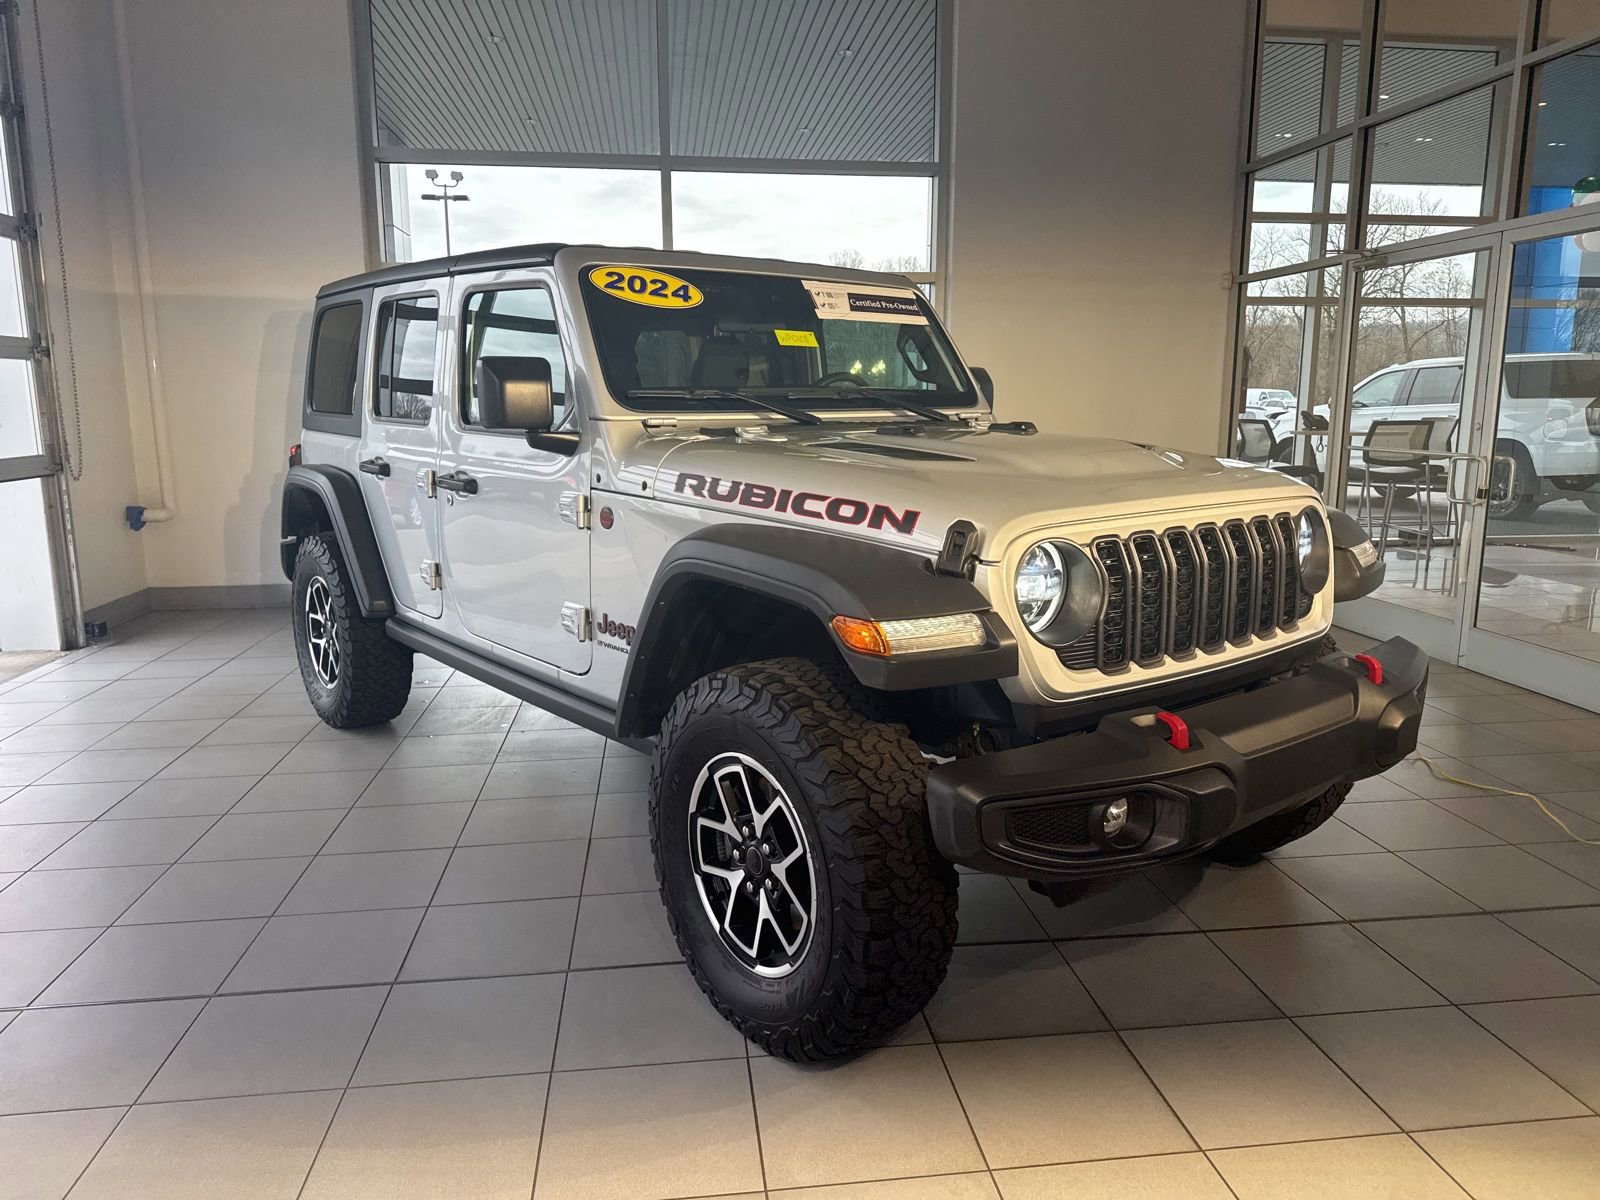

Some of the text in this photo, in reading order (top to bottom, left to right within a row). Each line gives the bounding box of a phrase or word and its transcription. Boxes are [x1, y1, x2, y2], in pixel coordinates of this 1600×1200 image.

[603, 271, 692, 304] 2024
[850, 299, 881, 308] Certified
[882, 302, 918, 311] Pre-Owned
[674, 472, 921, 536] RUBICON
[597, 612, 636, 646] Jeep
